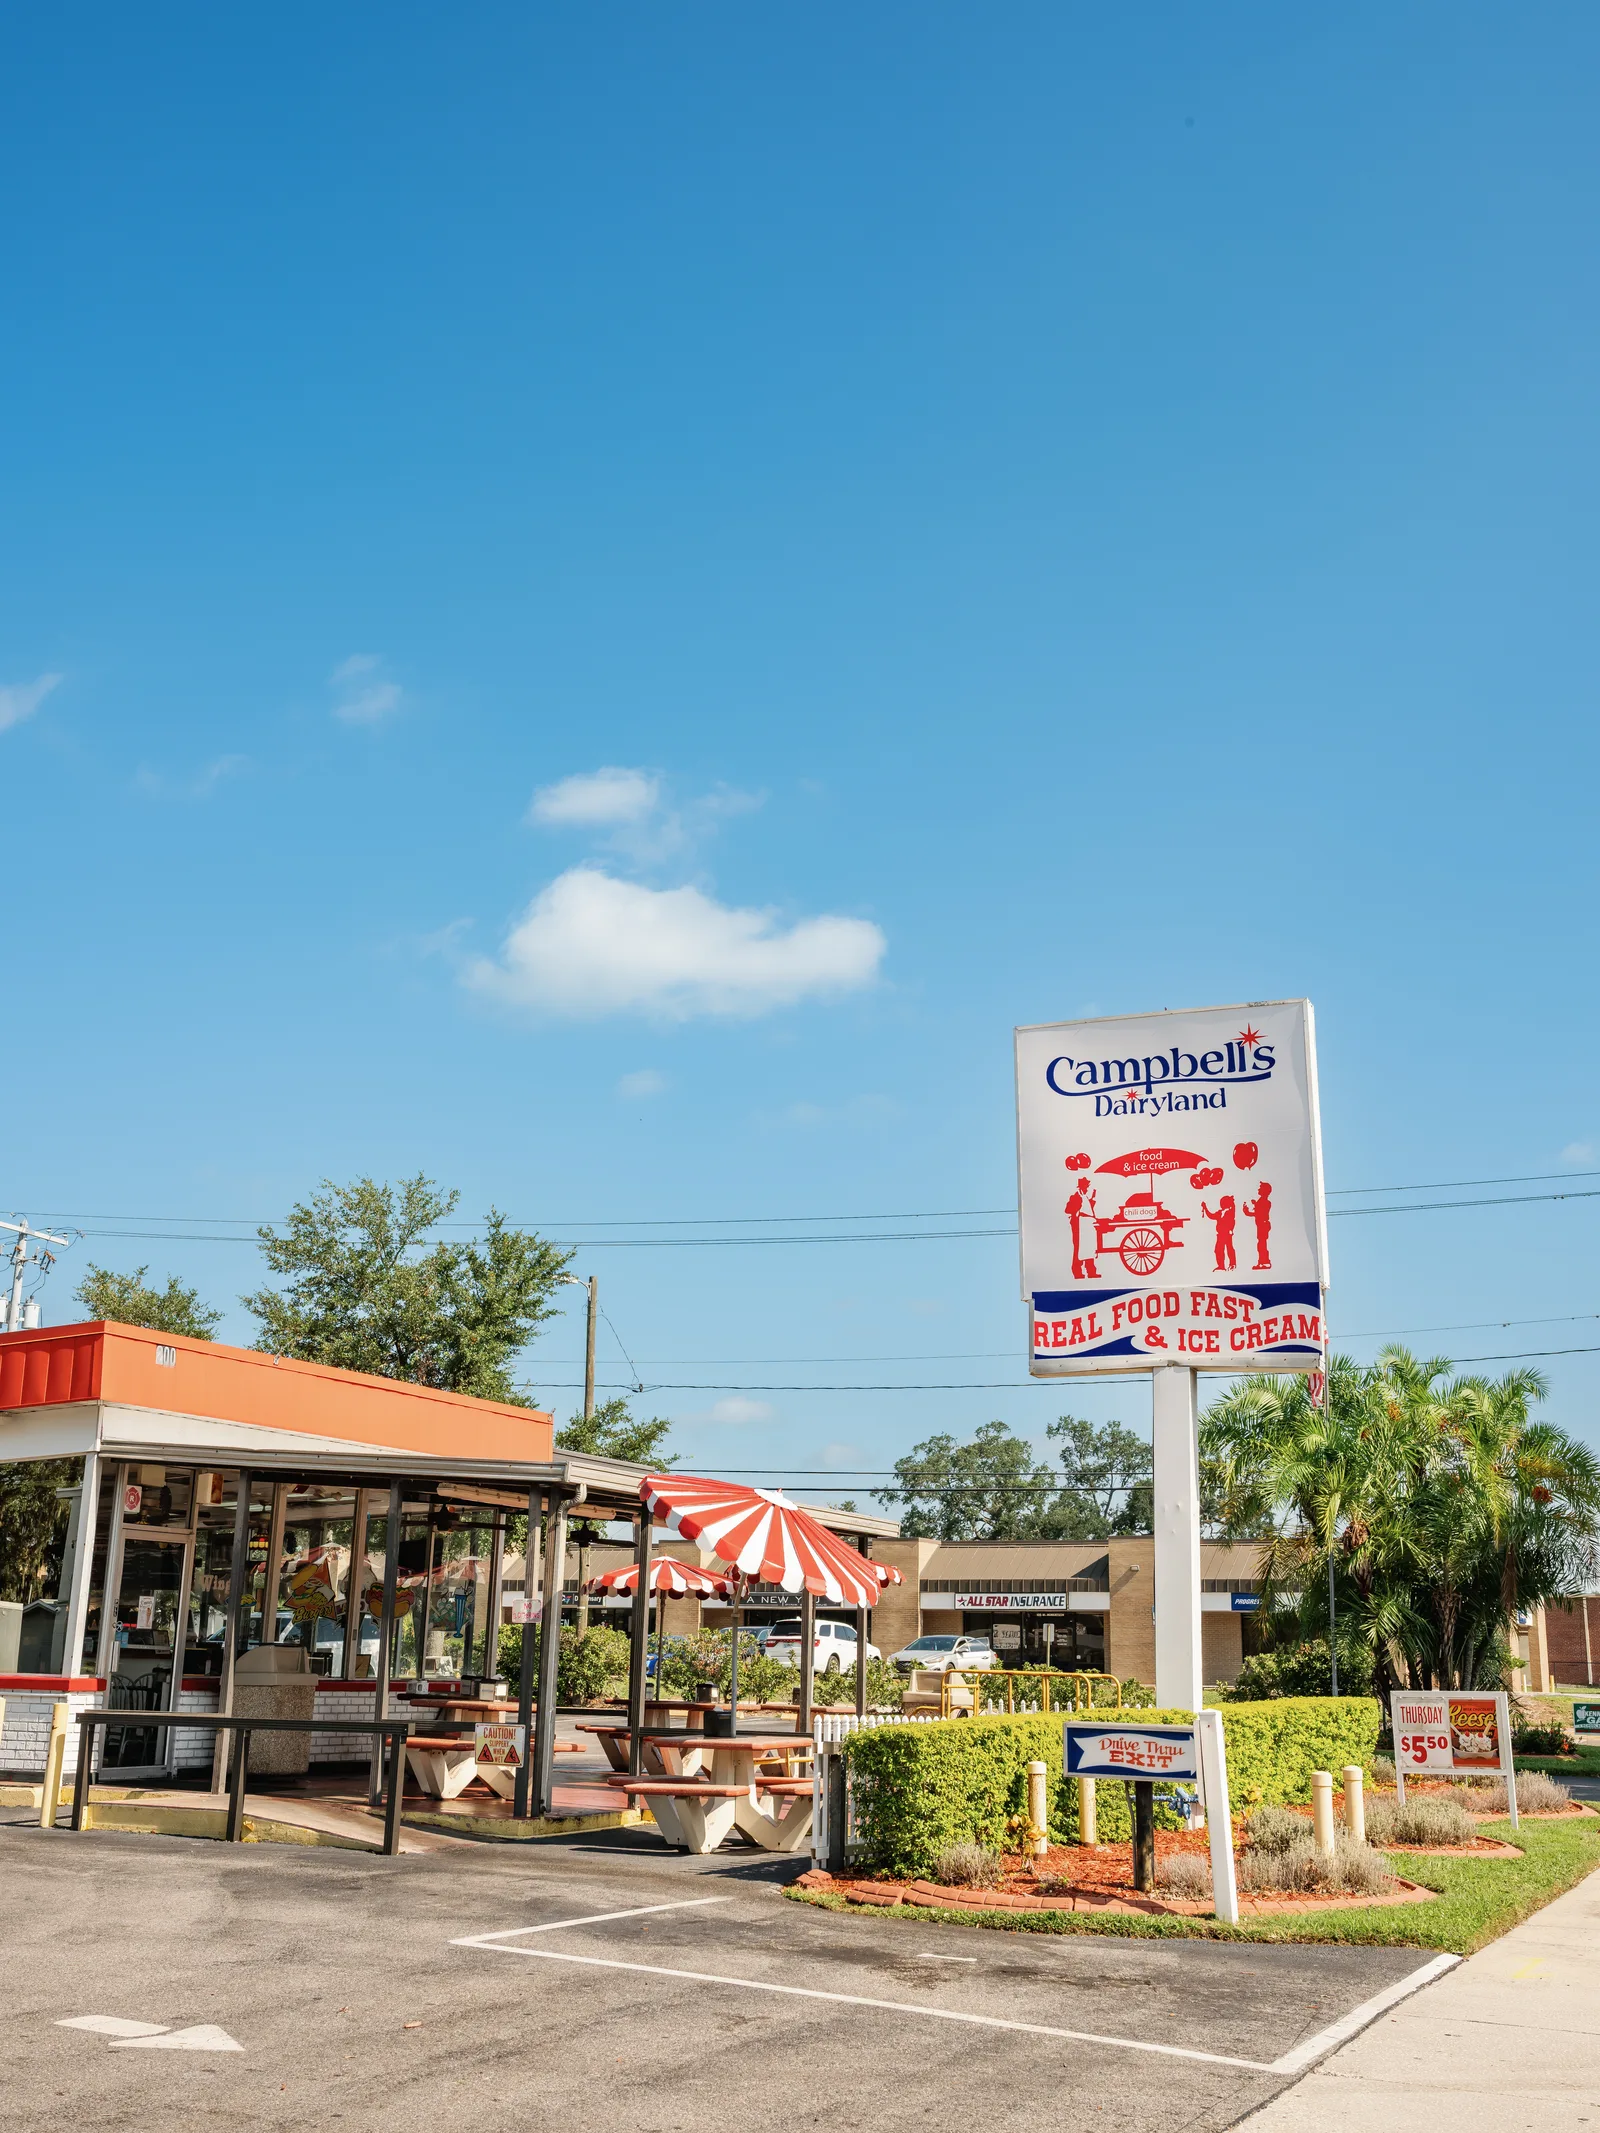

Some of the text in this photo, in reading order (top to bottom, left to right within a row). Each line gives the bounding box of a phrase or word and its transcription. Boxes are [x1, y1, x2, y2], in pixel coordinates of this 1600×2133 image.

[1046, 1040, 1276, 1096] Campbell's
[1095, 1088, 1227, 1117] Dairyland
[1140, 1150, 1162, 1161] food
[1124, 1161, 1180, 1171] & ice cream
[1140, 1208, 1156, 1216] dogs
[1034, 1291, 1254, 1348] REAL FOOD FAST
[1144, 1314, 1321, 1353] & ICE CREAM
[575, 1595, 602, 1603] Dnsary
[967, 1596, 1065, 1606] ALL STAR INSURANCE
[293, 1605, 332, 1625] Burgers
[1400, 1706, 1443, 1724] THURSDAY
[483, 1727, 516, 1739] CAUTION!
[1098, 1737, 1185, 1755] Drive Thru
[1109, 1751, 1172, 1768] EXIT
